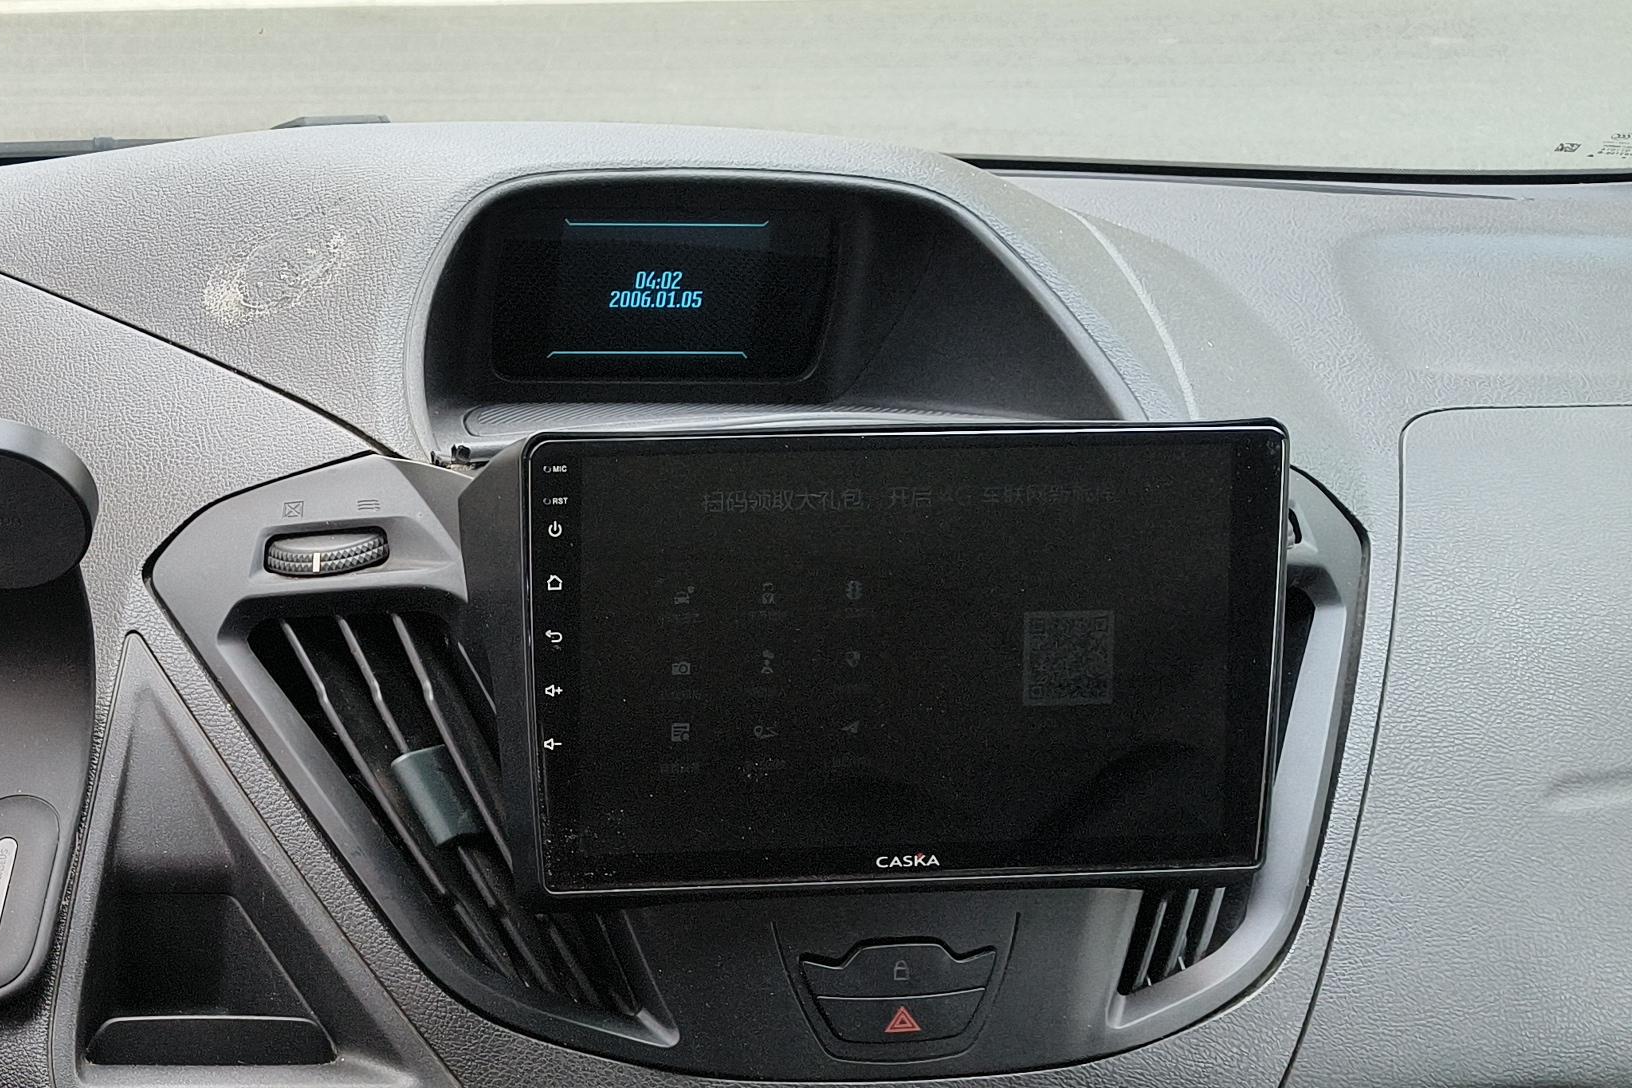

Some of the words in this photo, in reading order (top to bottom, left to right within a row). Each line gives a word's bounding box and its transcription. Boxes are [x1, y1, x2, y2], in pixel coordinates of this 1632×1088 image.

[635, 271, 683, 290] 04:02
[609, 290, 703, 309] 2006.01.05
[552, 465, 567, 473] MIC
[552, 497, 568, 505] RST
[876, 854, 940, 868] CASKA
